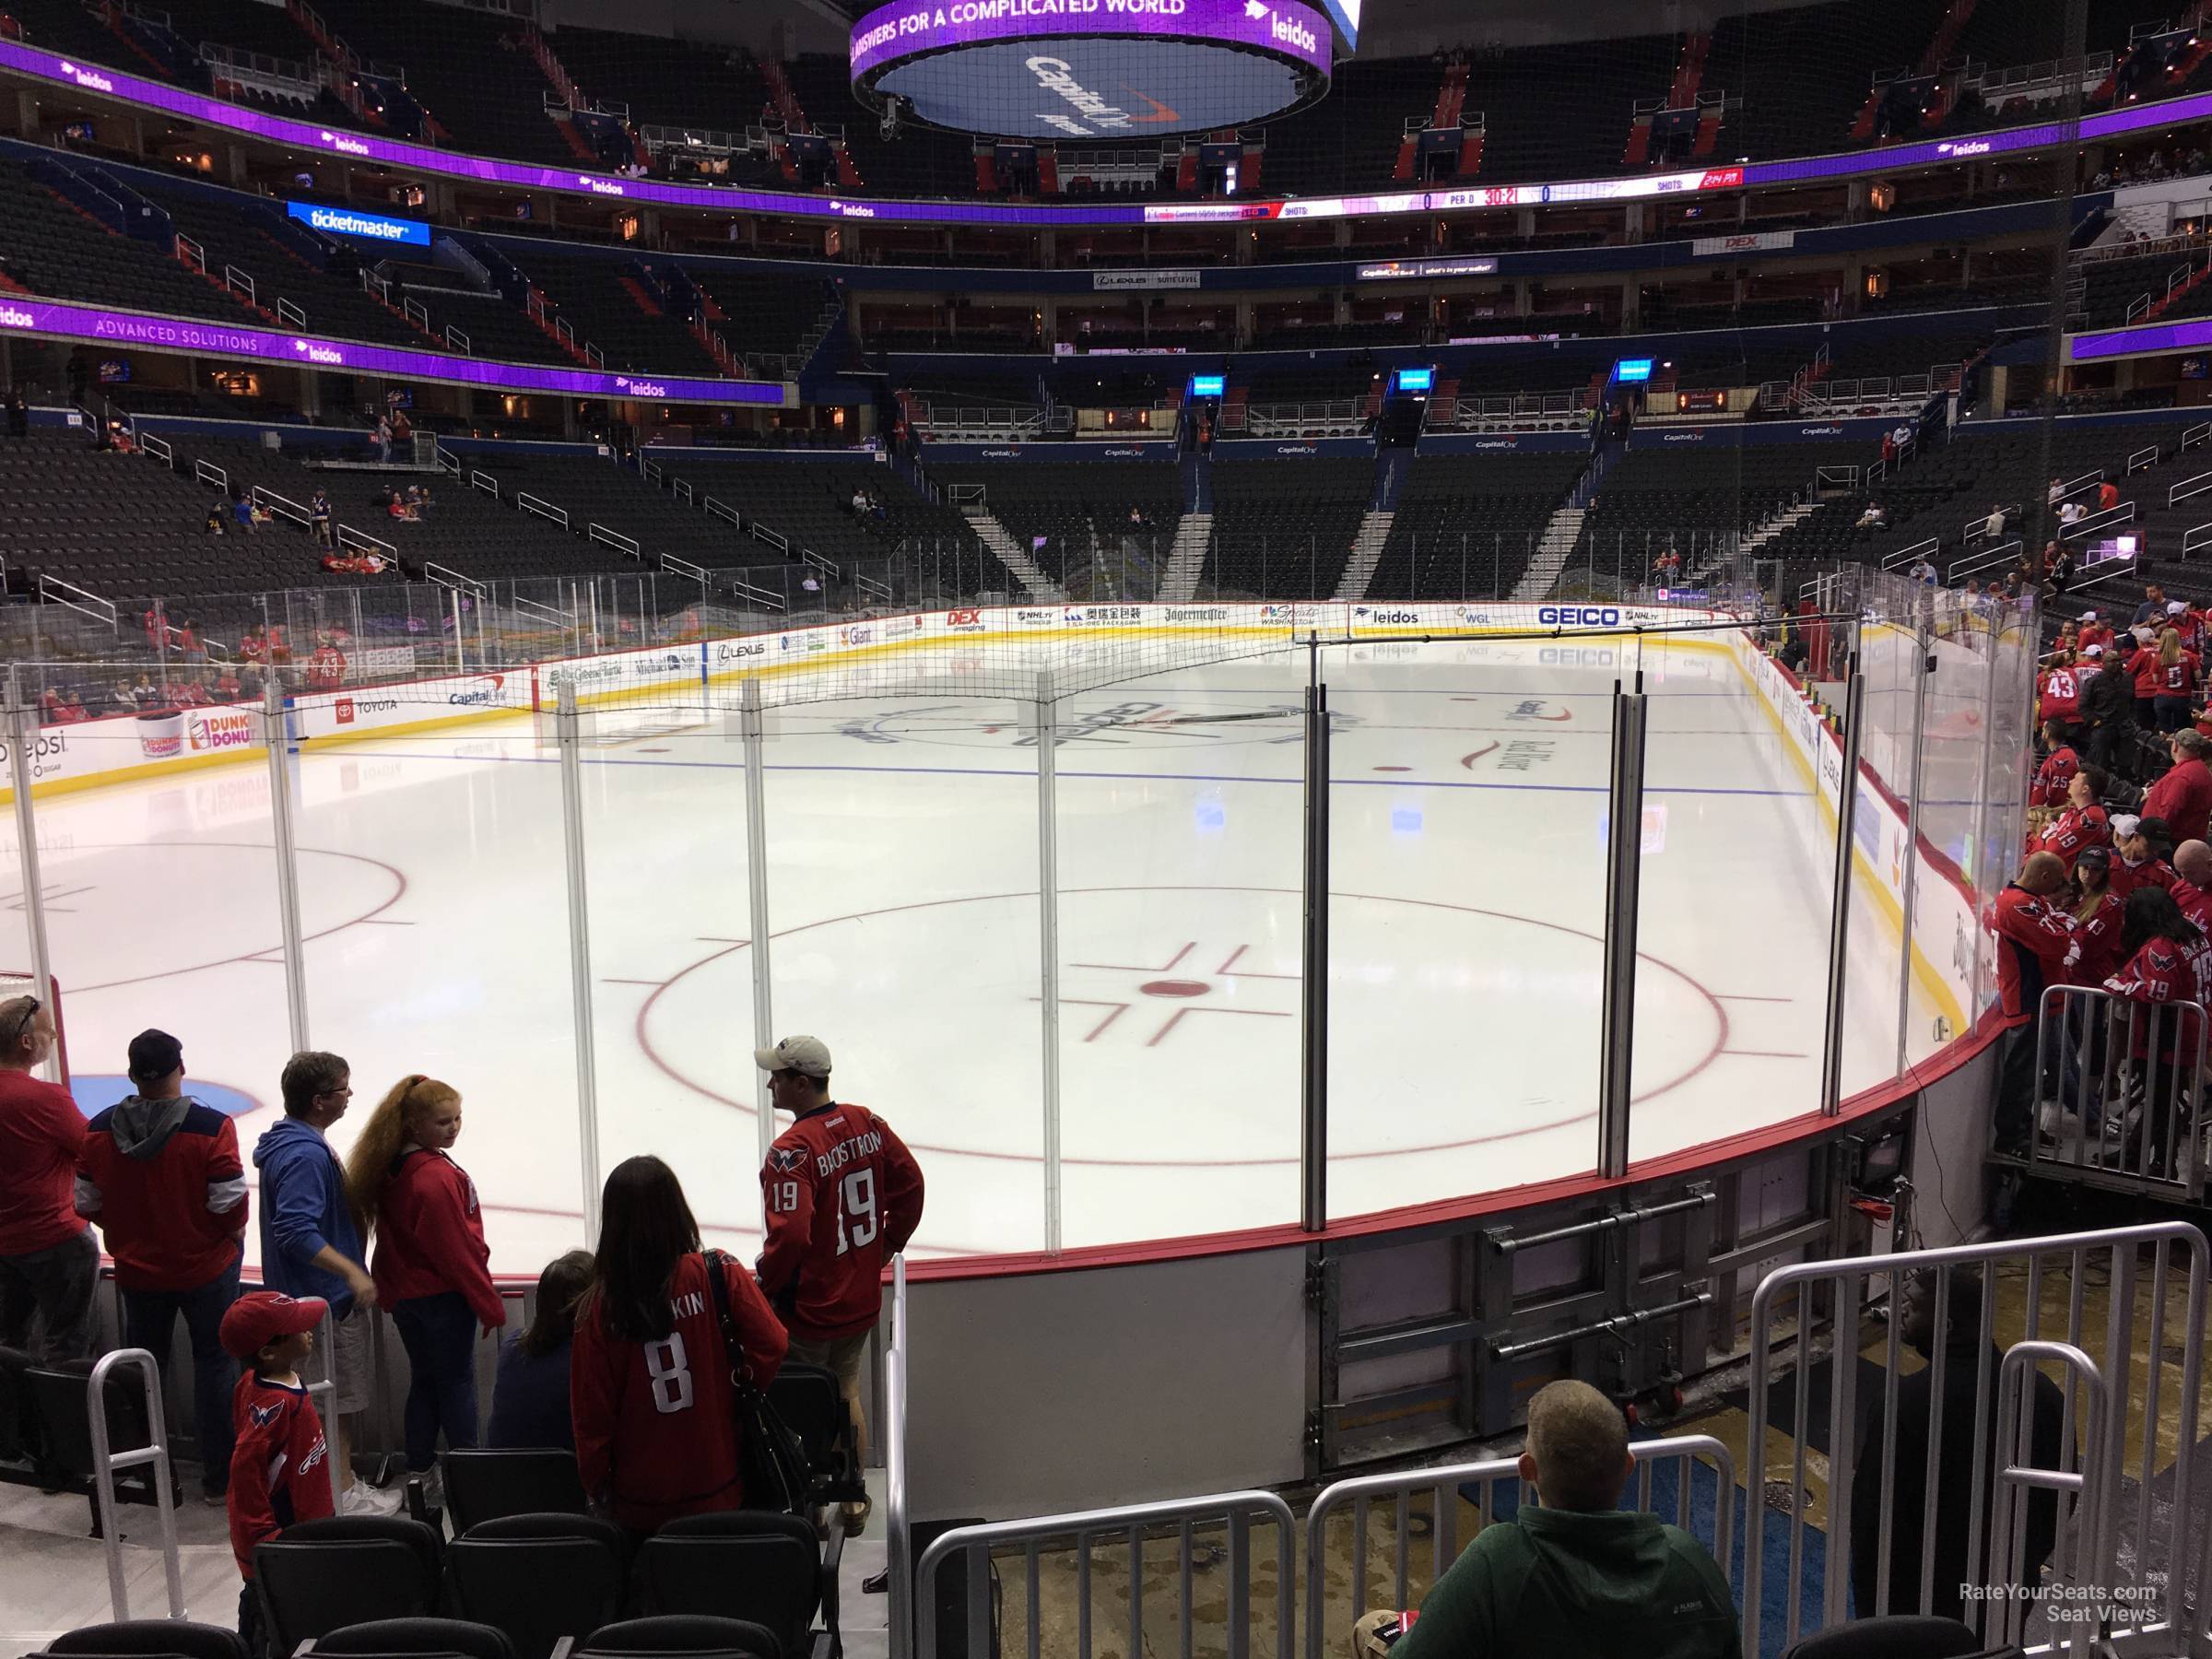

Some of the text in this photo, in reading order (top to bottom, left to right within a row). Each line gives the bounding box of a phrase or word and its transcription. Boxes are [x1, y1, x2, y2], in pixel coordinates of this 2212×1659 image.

[855, 20, 896, 57] ANSWERS
[900, 12, 929, 36] FOR
[934, 11, 947, 28] A
[950, 0, 1099, 24] COMPLICATED
[1105, 0, 1186, 15] WORLD
[1272, 11, 1316, 53] leidos
[76, 68, 112, 91] leidos
[335, 136, 369, 155] leidos
[1953, 141, 1990, 156] leidos
[1657, 179, 1683, 191] SHOTS:
[1724, 172, 1738, 182] PM
[593, 180, 623, 194] leidos
[1485, 186, 1518, 206] 30:21
[1542, 184, 1550, 203] 0
[1424, 191, 1431, 210] 0
[1451, 194, 1465, 205] PER
[843, 204, 874, 217] leidos
[1285, 206, 1308, 216] SHOTS:
[312, 210, 405, 239] ticketmaster
[1725, 236, 1756, 248] DEX
[0, 306, 342, 364] idos ADVANCED SOLUTIONS leidos
[630, 381, 665, 397] leidos
[947, 610, 982, 627] DEX
[1374, 611, 1418, 624] leidos
[1466, 614, 1490, 624] WGL
[1539, 607, 1619, 626] GEICO
[850, 628, 872, 645] Giant
[731, 645, 765, 658] LEXUS
[2048, 677, 2075, 699] 43
[357, 700, 397, 714] TOYOTA
[210, 714, 249, 733] DUNK
[213, 729, 252, 747] DONU
[2051, 775, 2068, 789] 25
[2058, 830, 2078, 848] 19
[2087, 918, 2106, 935] 43
[2147, 979, 2170, 1001] 19
[773, 1181, 798, 1213] 19
[836, 1167, 878, 1257] 19
[644, 1331, 694, 1415] 8
